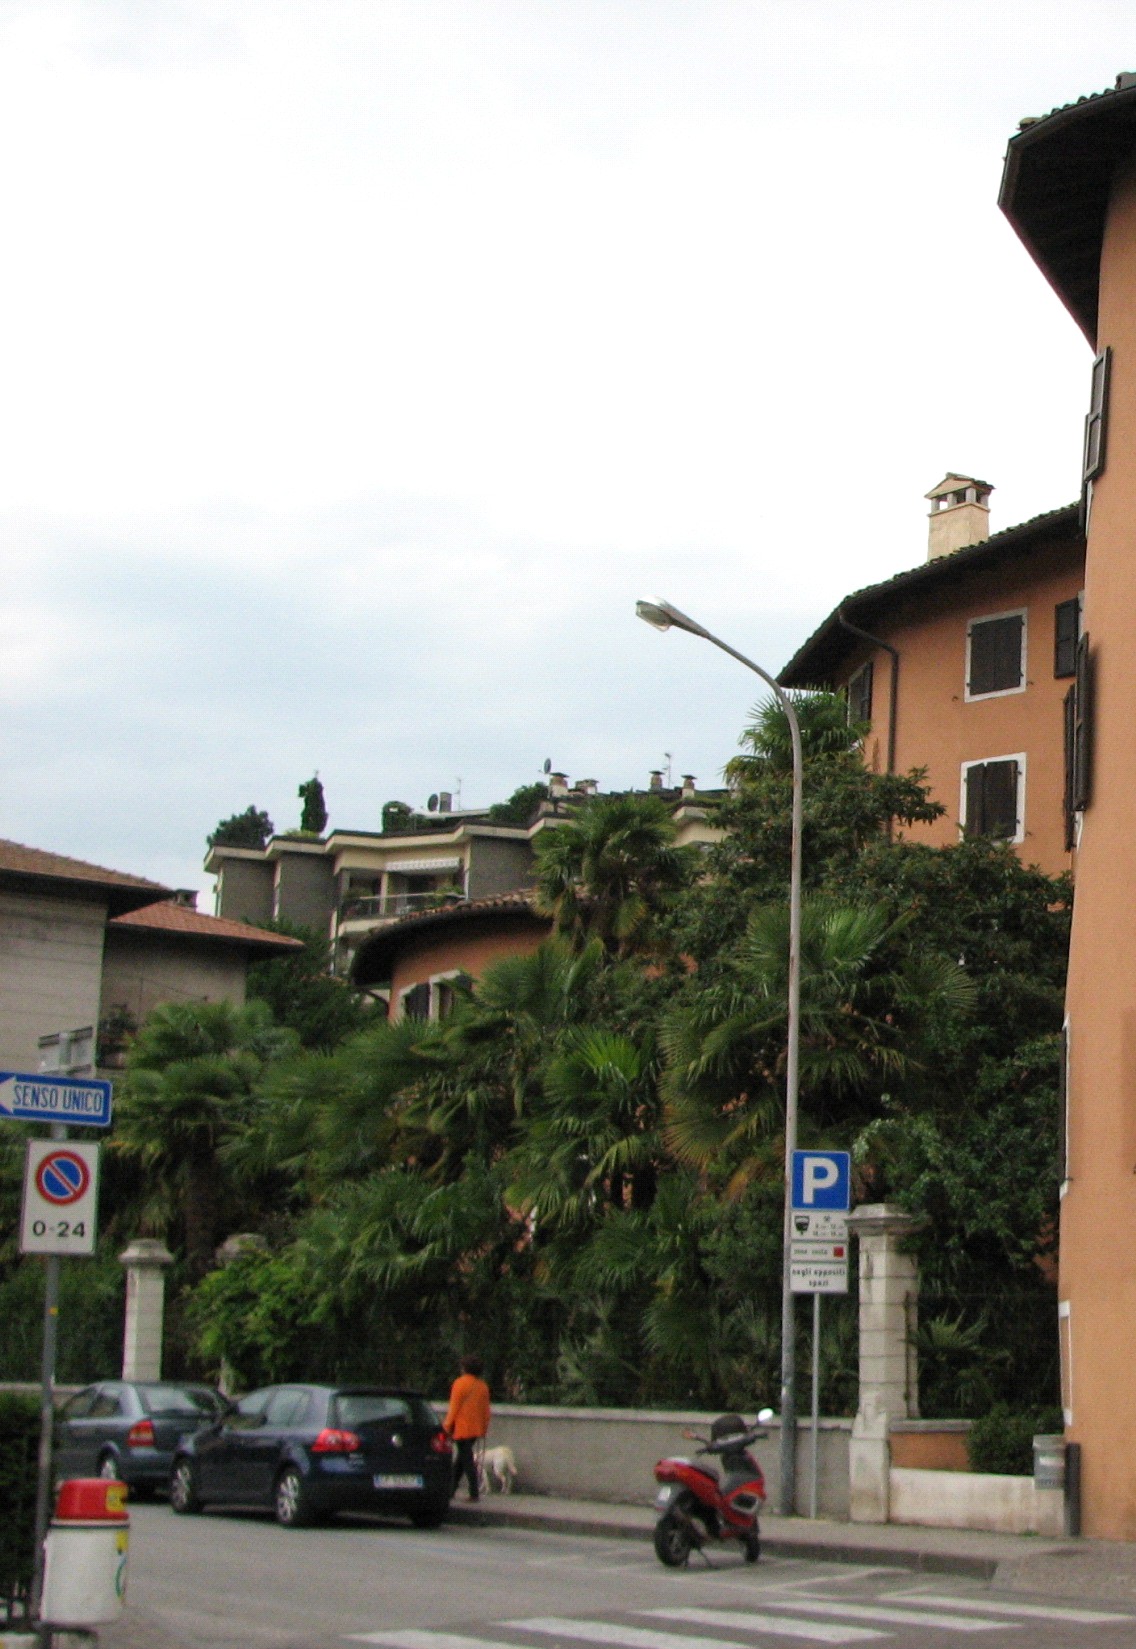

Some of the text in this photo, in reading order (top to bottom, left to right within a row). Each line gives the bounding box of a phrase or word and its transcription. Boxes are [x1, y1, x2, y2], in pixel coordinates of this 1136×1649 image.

[13, 1085, 103, 1113] SENSO UNICO
[803, 1157, 838, 1204] P
[32, 1219, 86, 1238] 0-24
